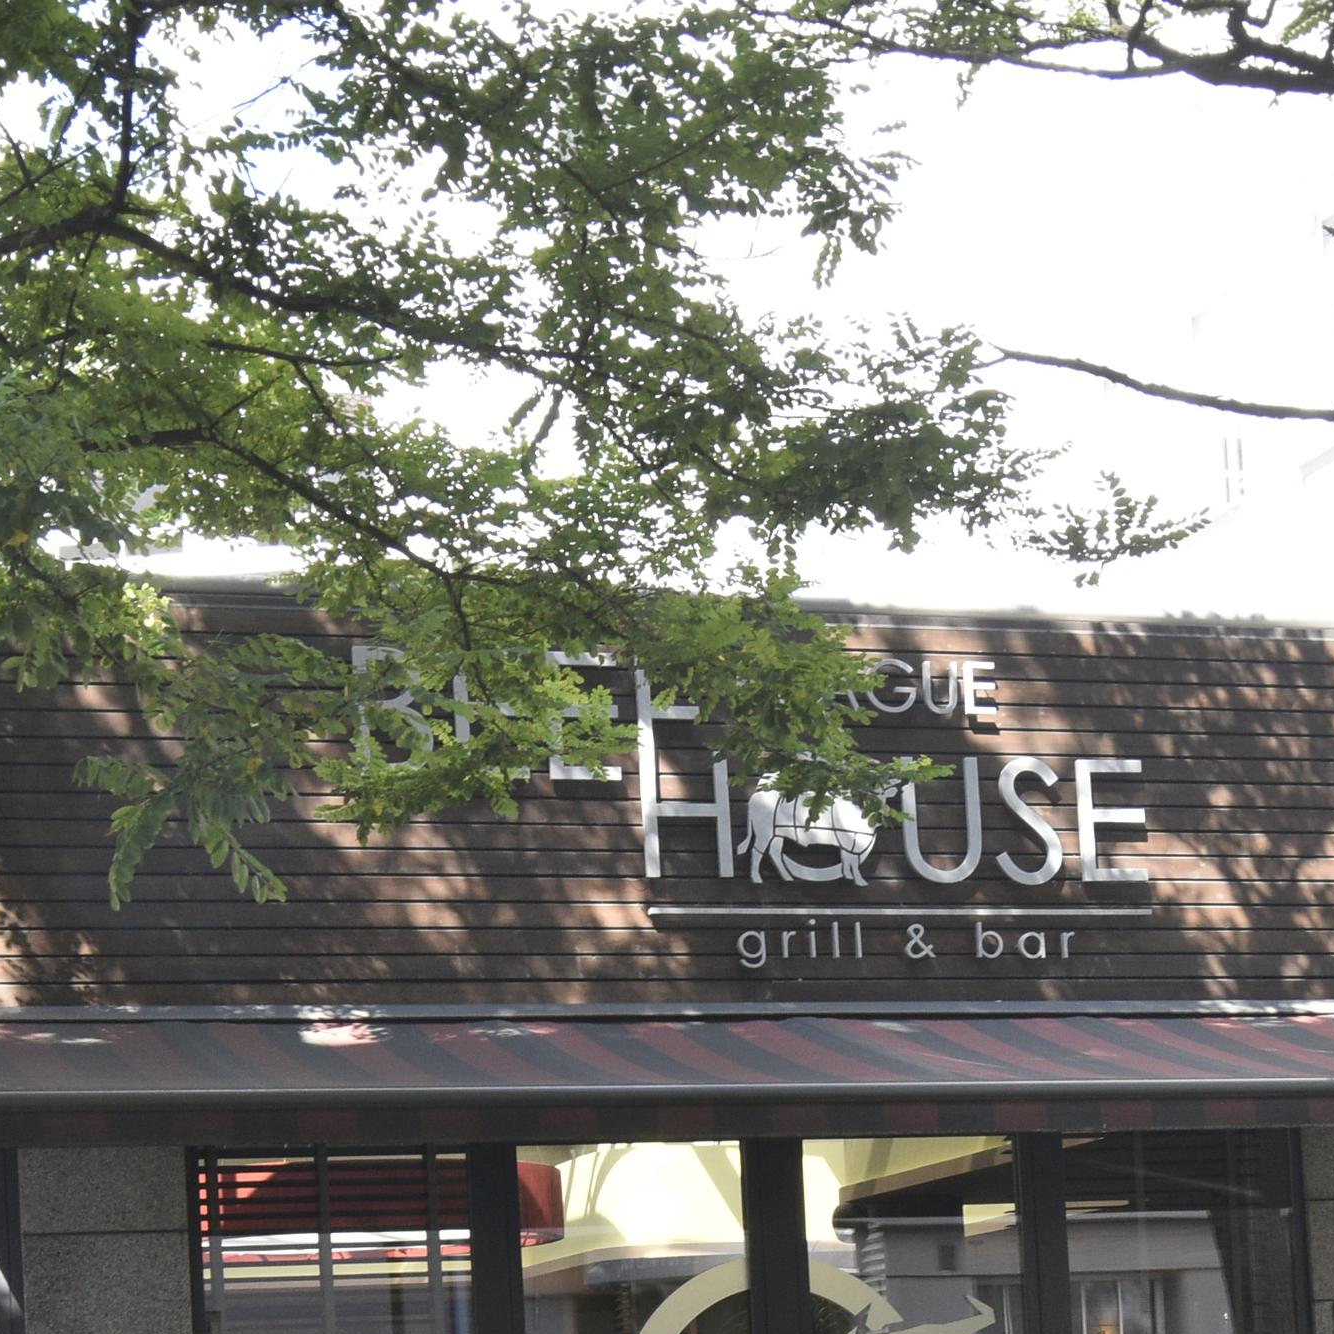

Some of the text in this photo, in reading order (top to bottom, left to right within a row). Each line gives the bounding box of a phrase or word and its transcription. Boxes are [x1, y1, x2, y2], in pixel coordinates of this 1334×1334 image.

[736, 919, 1075, 968] grill & bar
